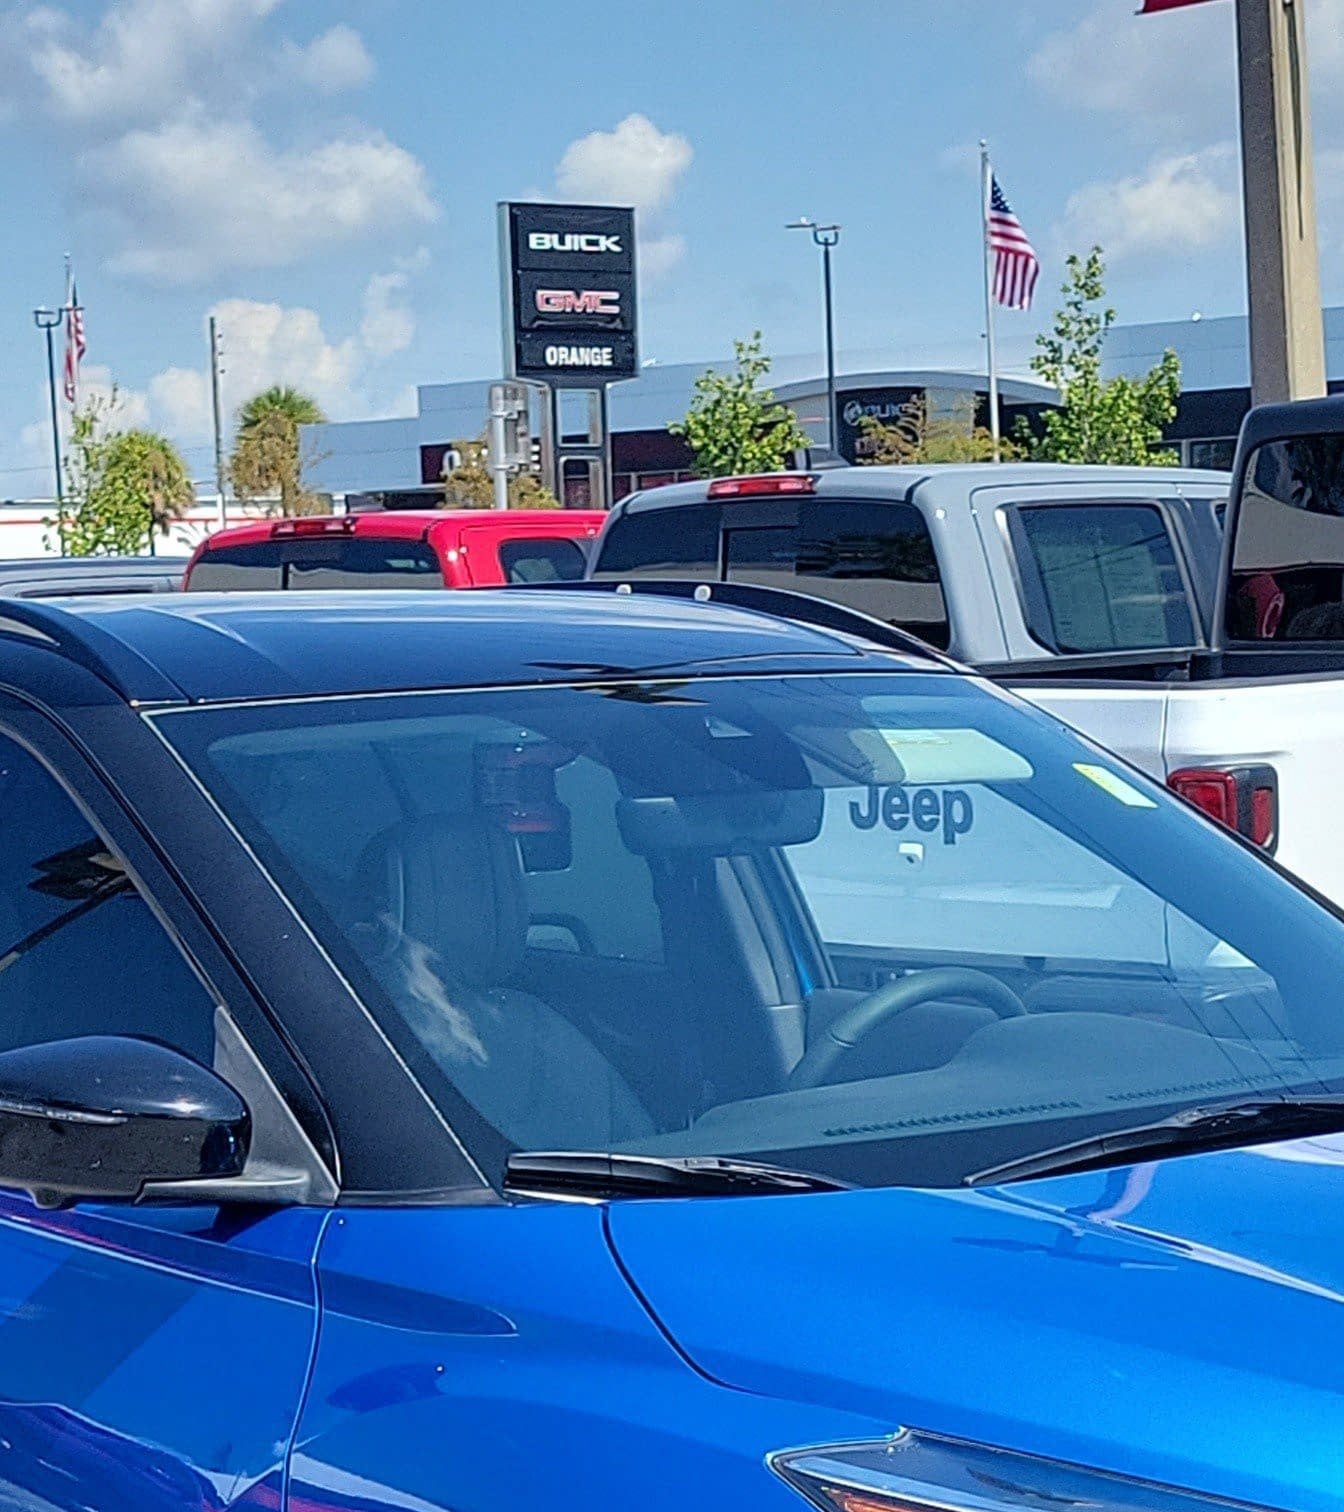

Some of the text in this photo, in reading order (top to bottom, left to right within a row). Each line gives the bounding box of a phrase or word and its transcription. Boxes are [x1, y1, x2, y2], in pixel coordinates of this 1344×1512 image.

[528, 233, 623, 252] BUICK
[536, 289, 620, 314] GMC
[545, 346, 614, 366] ORANGE
[849, 784, 974, 845] Jeep
